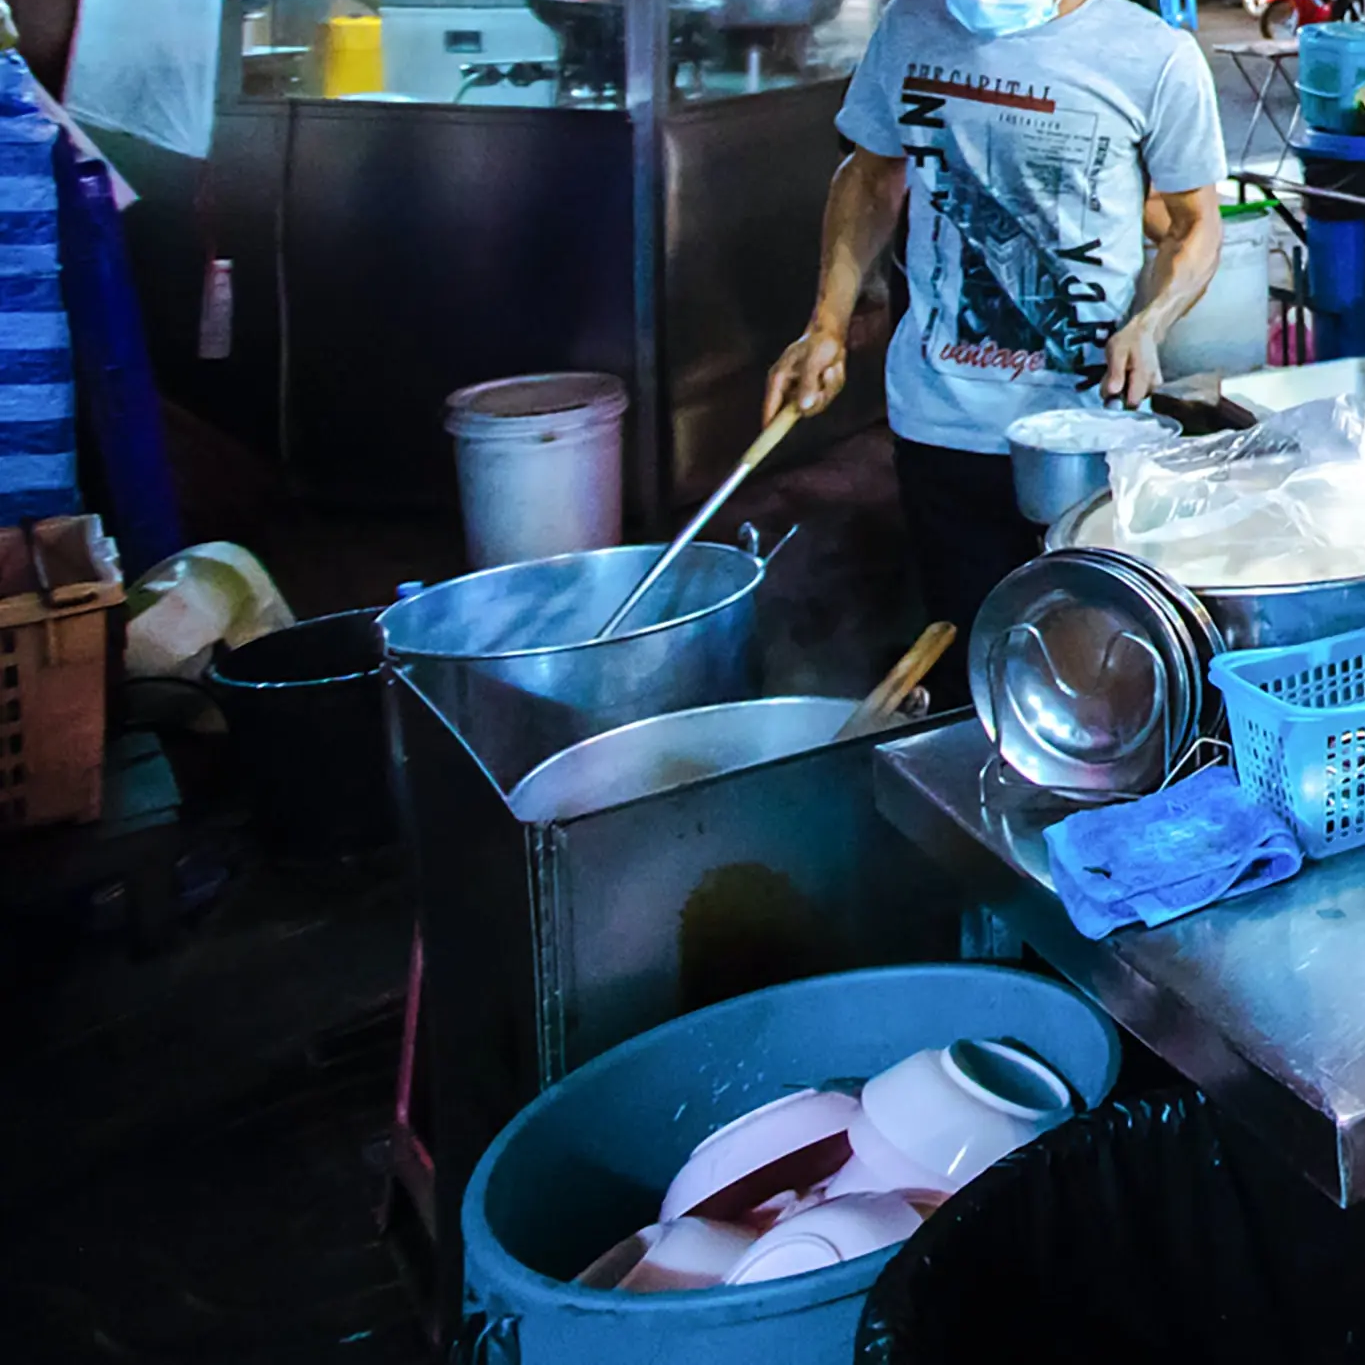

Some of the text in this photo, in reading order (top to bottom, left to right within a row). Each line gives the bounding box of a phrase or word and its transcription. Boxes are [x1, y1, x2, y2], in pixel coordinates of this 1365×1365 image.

[907, 63, 1051, 101] THE CAPITAL
[939, 338, 1046, 382] vintage
